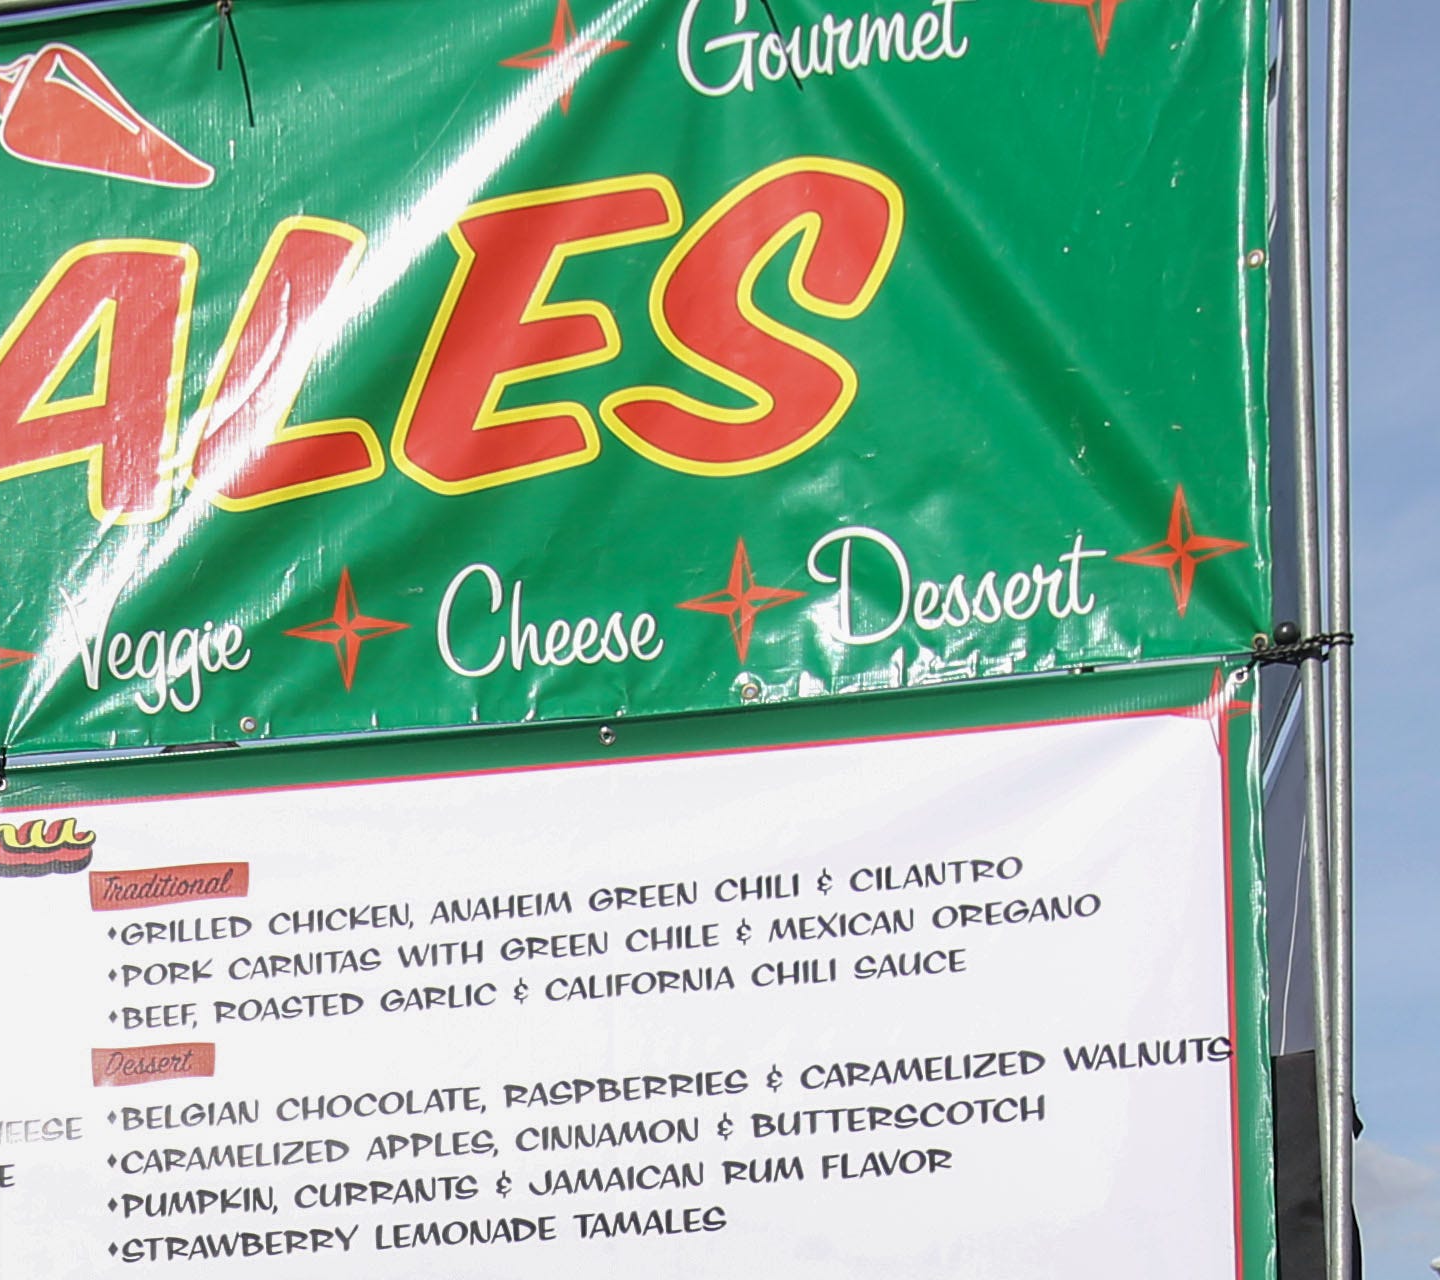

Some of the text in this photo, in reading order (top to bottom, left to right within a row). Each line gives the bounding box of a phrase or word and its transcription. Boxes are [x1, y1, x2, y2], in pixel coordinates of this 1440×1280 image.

[677, 0, 969, 97] Gourmet
[58, 590, 252, 715] Veggie
[434, 560, 665, 679] Cheese
[805, 524, 1109, 648] Dessert
[102, 867, 236, 902] Traditional
[120, 914, 254, 946] GRILLED
[267, 900, 415, 936] CHICKEN,
[428, 889, 573, 926] ANAHEIM
[587, 879, 698, 912] GREEN
[713, 871, 800, 903] CHILI
[848, 854, 1024, 893] CILANTRO
[121, 957, 214, 988] PORK
[227, 946, 383, 981] CARNITAS
[396, 938, 484, 969] WITH
[499, 929, 609, 962] GREEN
[624, 921, 721, 953] CHILE
[767, 905, 915, 944] MEXICAN
[931, 891, 1102, 930] OREGANO
[121, 1001, 199, 1031] BEEF,
[212, 991, 365, 1025] ROASTED
[379, 981, 499, 1013] GARLIC
[544, 963, 736, 1003] CALIFORNIA
[750, 956, 837, 988] CHILI
[853, 947, 968, 981] SAUCE
[103, 1048, 195, 1077] Dessert
[120, 1097, 260, 1132] BELGIAN
[275, 1085, 487, 1122] CHOCOLATE,
[501, 1067, 750, 1109] RASPBERRIES
[799, 1048, 1047, 1090] CARAMELIZED
[1062, 1030, 1235, 1073] WALNUTS
[120, 1137, 351, 1175] CARAMELIZED
[365, 1127, 500, 1163] APPLES,
[514, 1114, 700, 1153] CINNAMON
[749, 1092, 1046, 1139] BUTTERSCOTCH
[120, 1183, 279, 1220] PUMPKIN,
[293, 1173, 480, 1210] CURRANTS
[527, 1159, 705, 1197] JAMAICAN
[720, 1154, 805, 1186] RUM
[821, 1146, 953, 1181] FLAVOR
[121, 1204, 728, 1264] STRAWBERRY LEMONADE TAMALES
